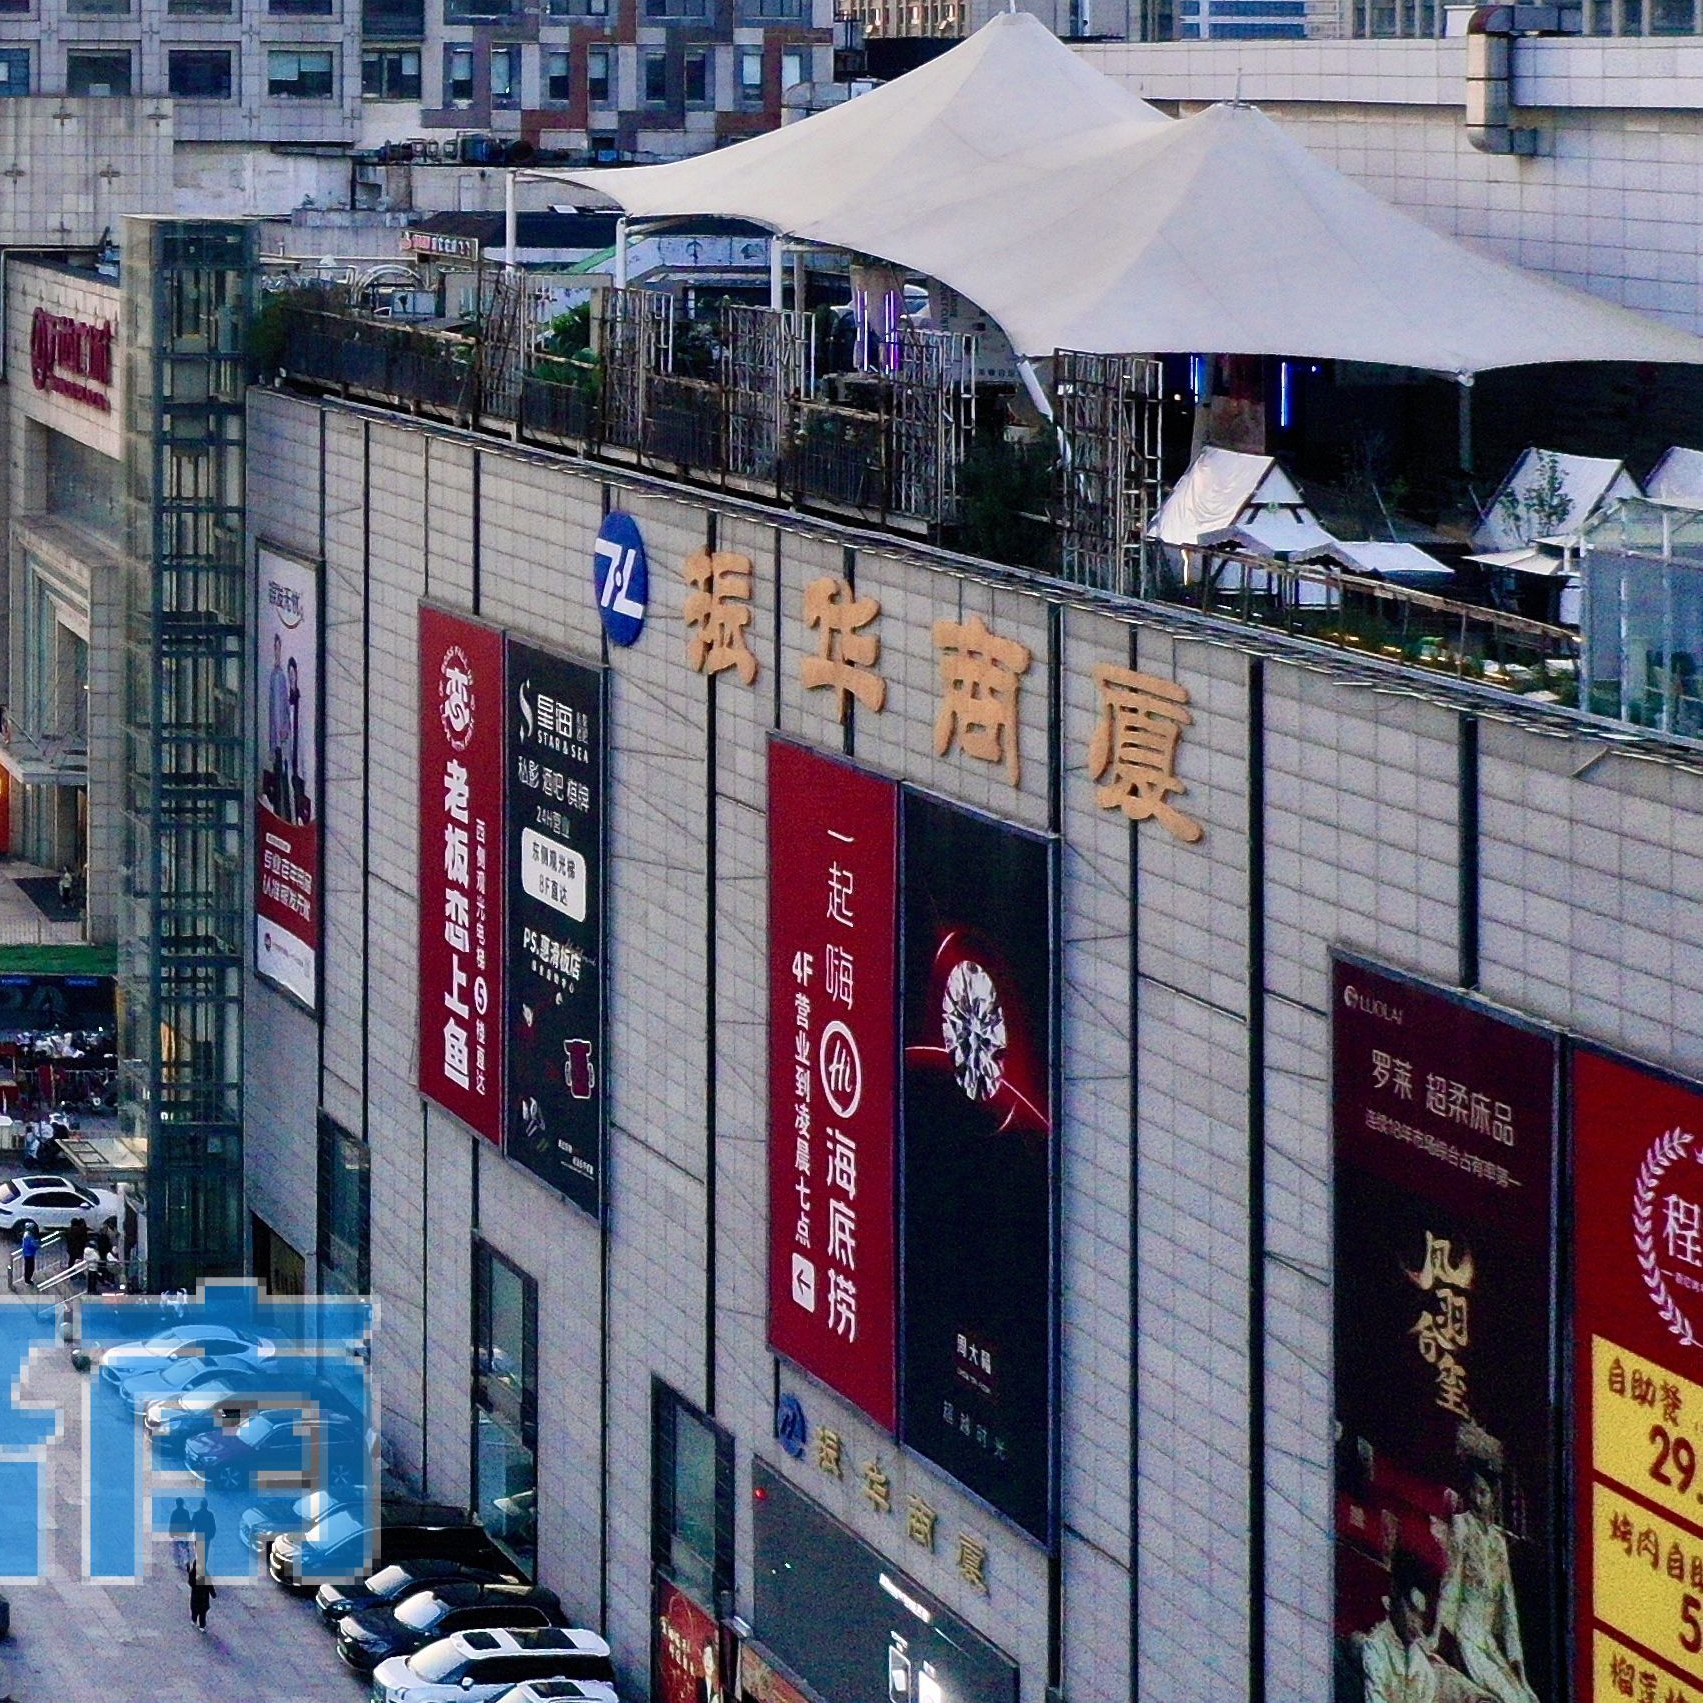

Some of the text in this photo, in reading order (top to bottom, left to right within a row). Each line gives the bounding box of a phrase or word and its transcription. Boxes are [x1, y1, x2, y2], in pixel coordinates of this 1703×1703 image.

[444, 758, 471, 1091] 老板恋上鱼
[1370, 1048, 1515, 1148] 罗莱 超柔床品
[825, 1125, 857, 1345] 海底捞
[1607, 1356, 1682, 1428] 自助餐
[816, 1426, 992, 1599] 振华商厦
